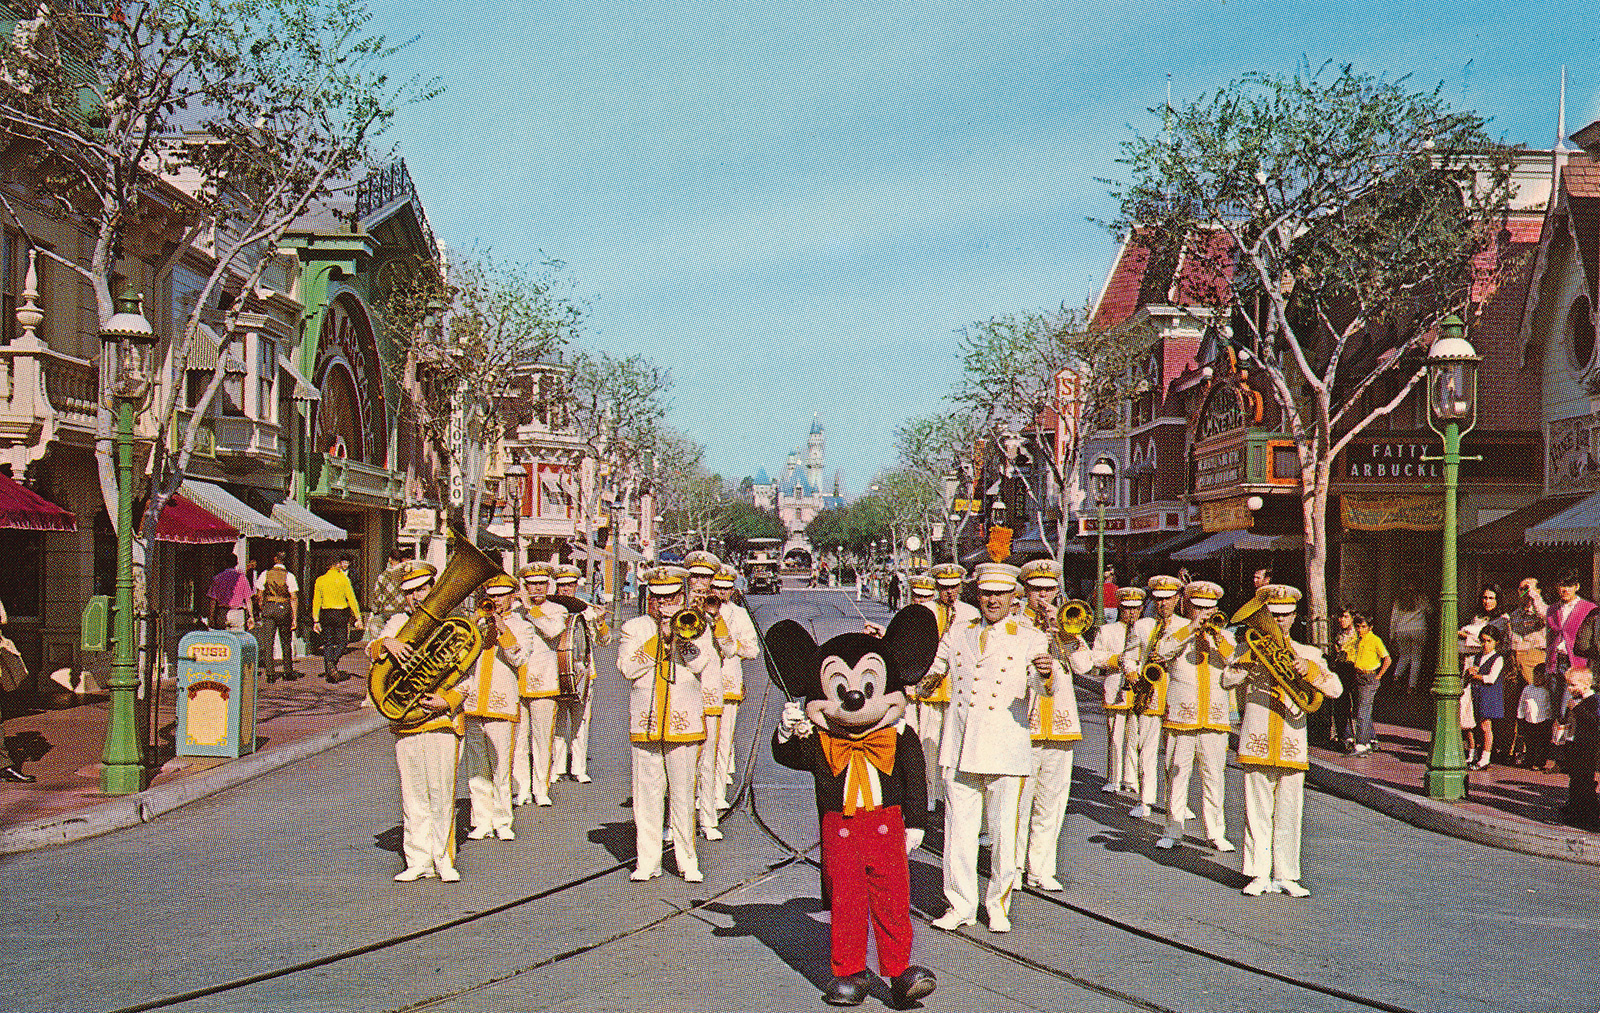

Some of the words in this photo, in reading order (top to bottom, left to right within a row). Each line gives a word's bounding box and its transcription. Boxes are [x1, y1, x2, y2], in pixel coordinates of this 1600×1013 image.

[1372, 444, 1429, 458] FATTY
[1350, 463, 1446, 477] ARBUCKL
[192, 647, 228, 658] PUSH
